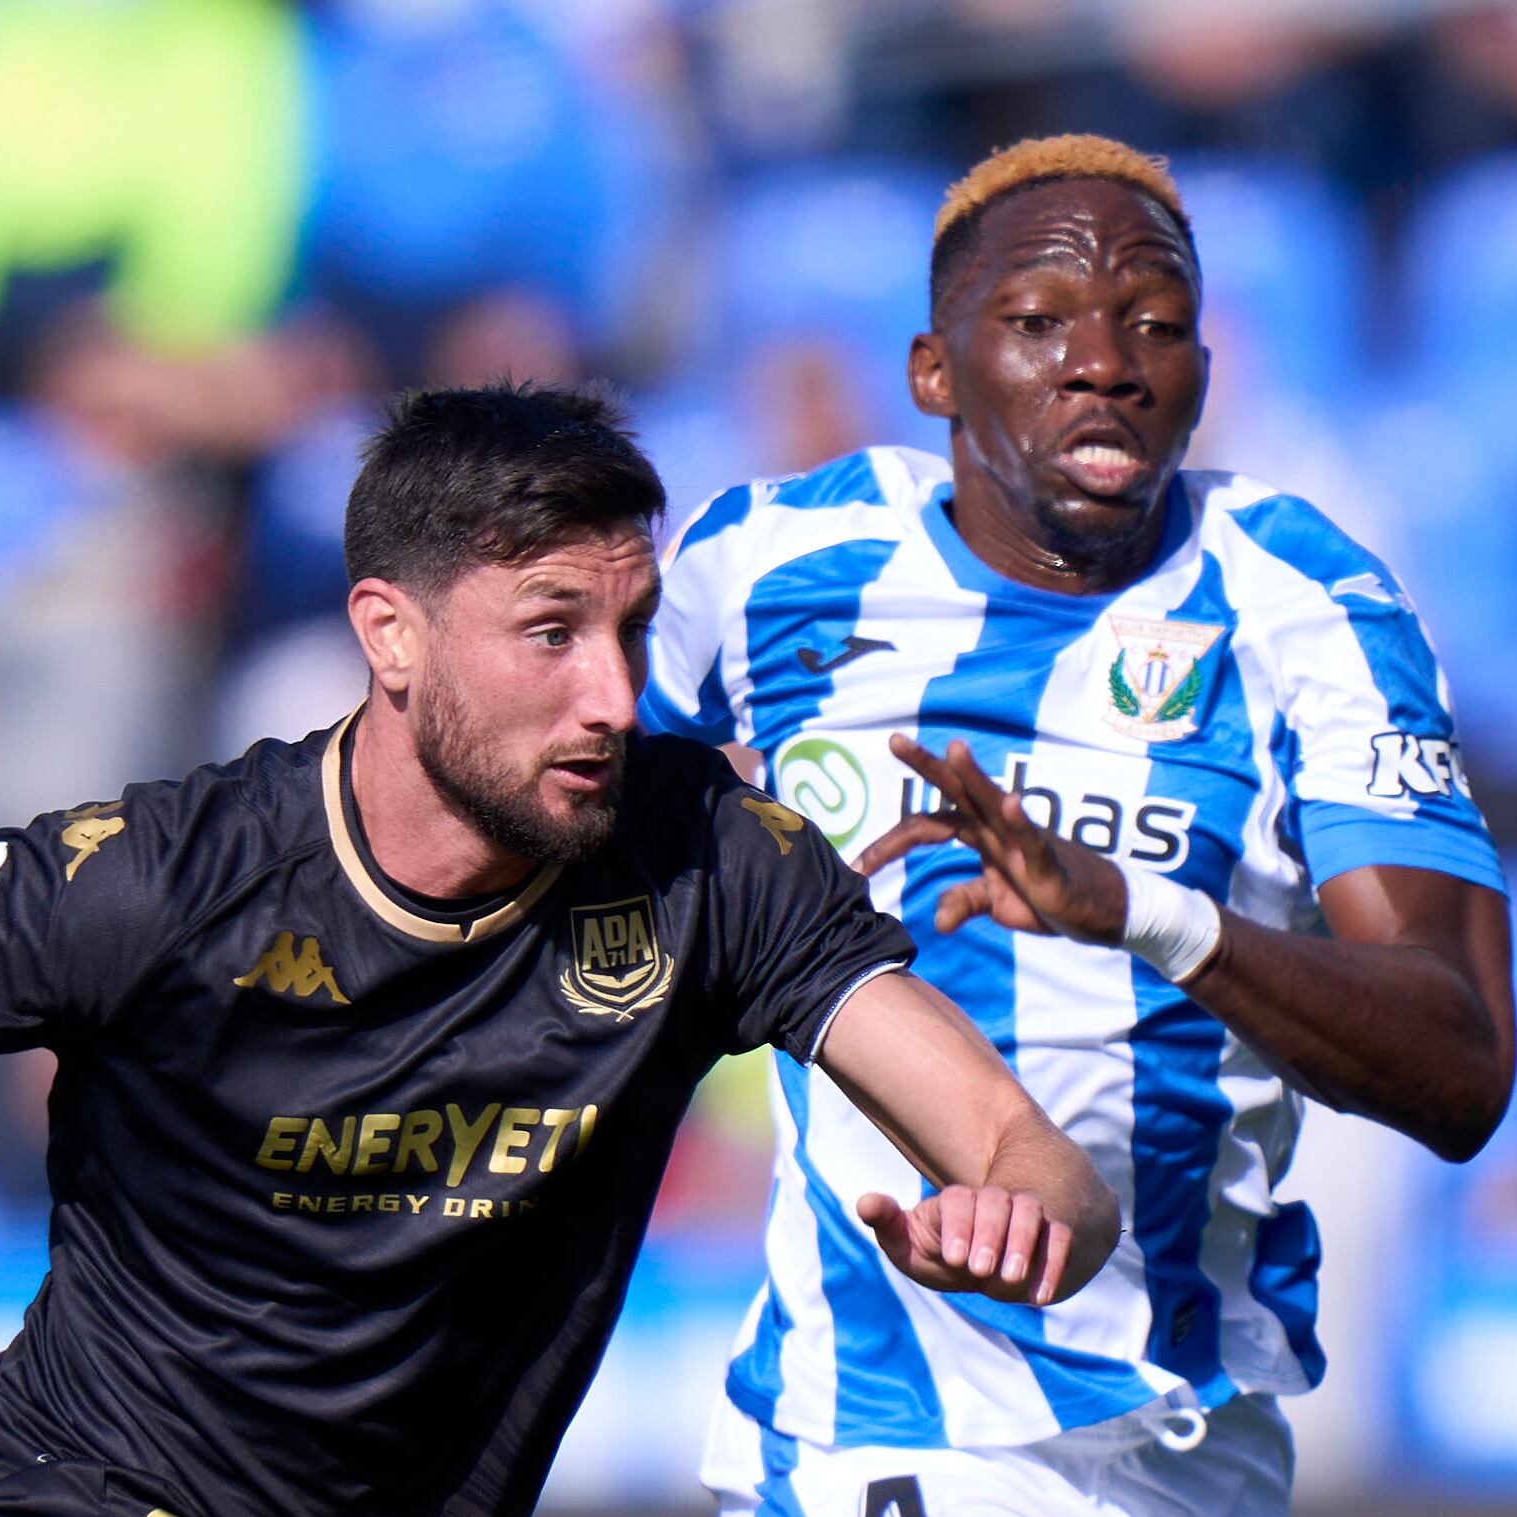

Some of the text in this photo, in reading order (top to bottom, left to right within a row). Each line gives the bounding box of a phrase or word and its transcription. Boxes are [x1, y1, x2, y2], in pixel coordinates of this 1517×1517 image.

[901, 761, 1187, 862] bas
[582, 910, 654, 971] ADA
[607, 950, 628, 967] 71
[255, 1102, 598, 1188] ENERYETI
[273, 1191, 538, 1218] ENERGY DRI
